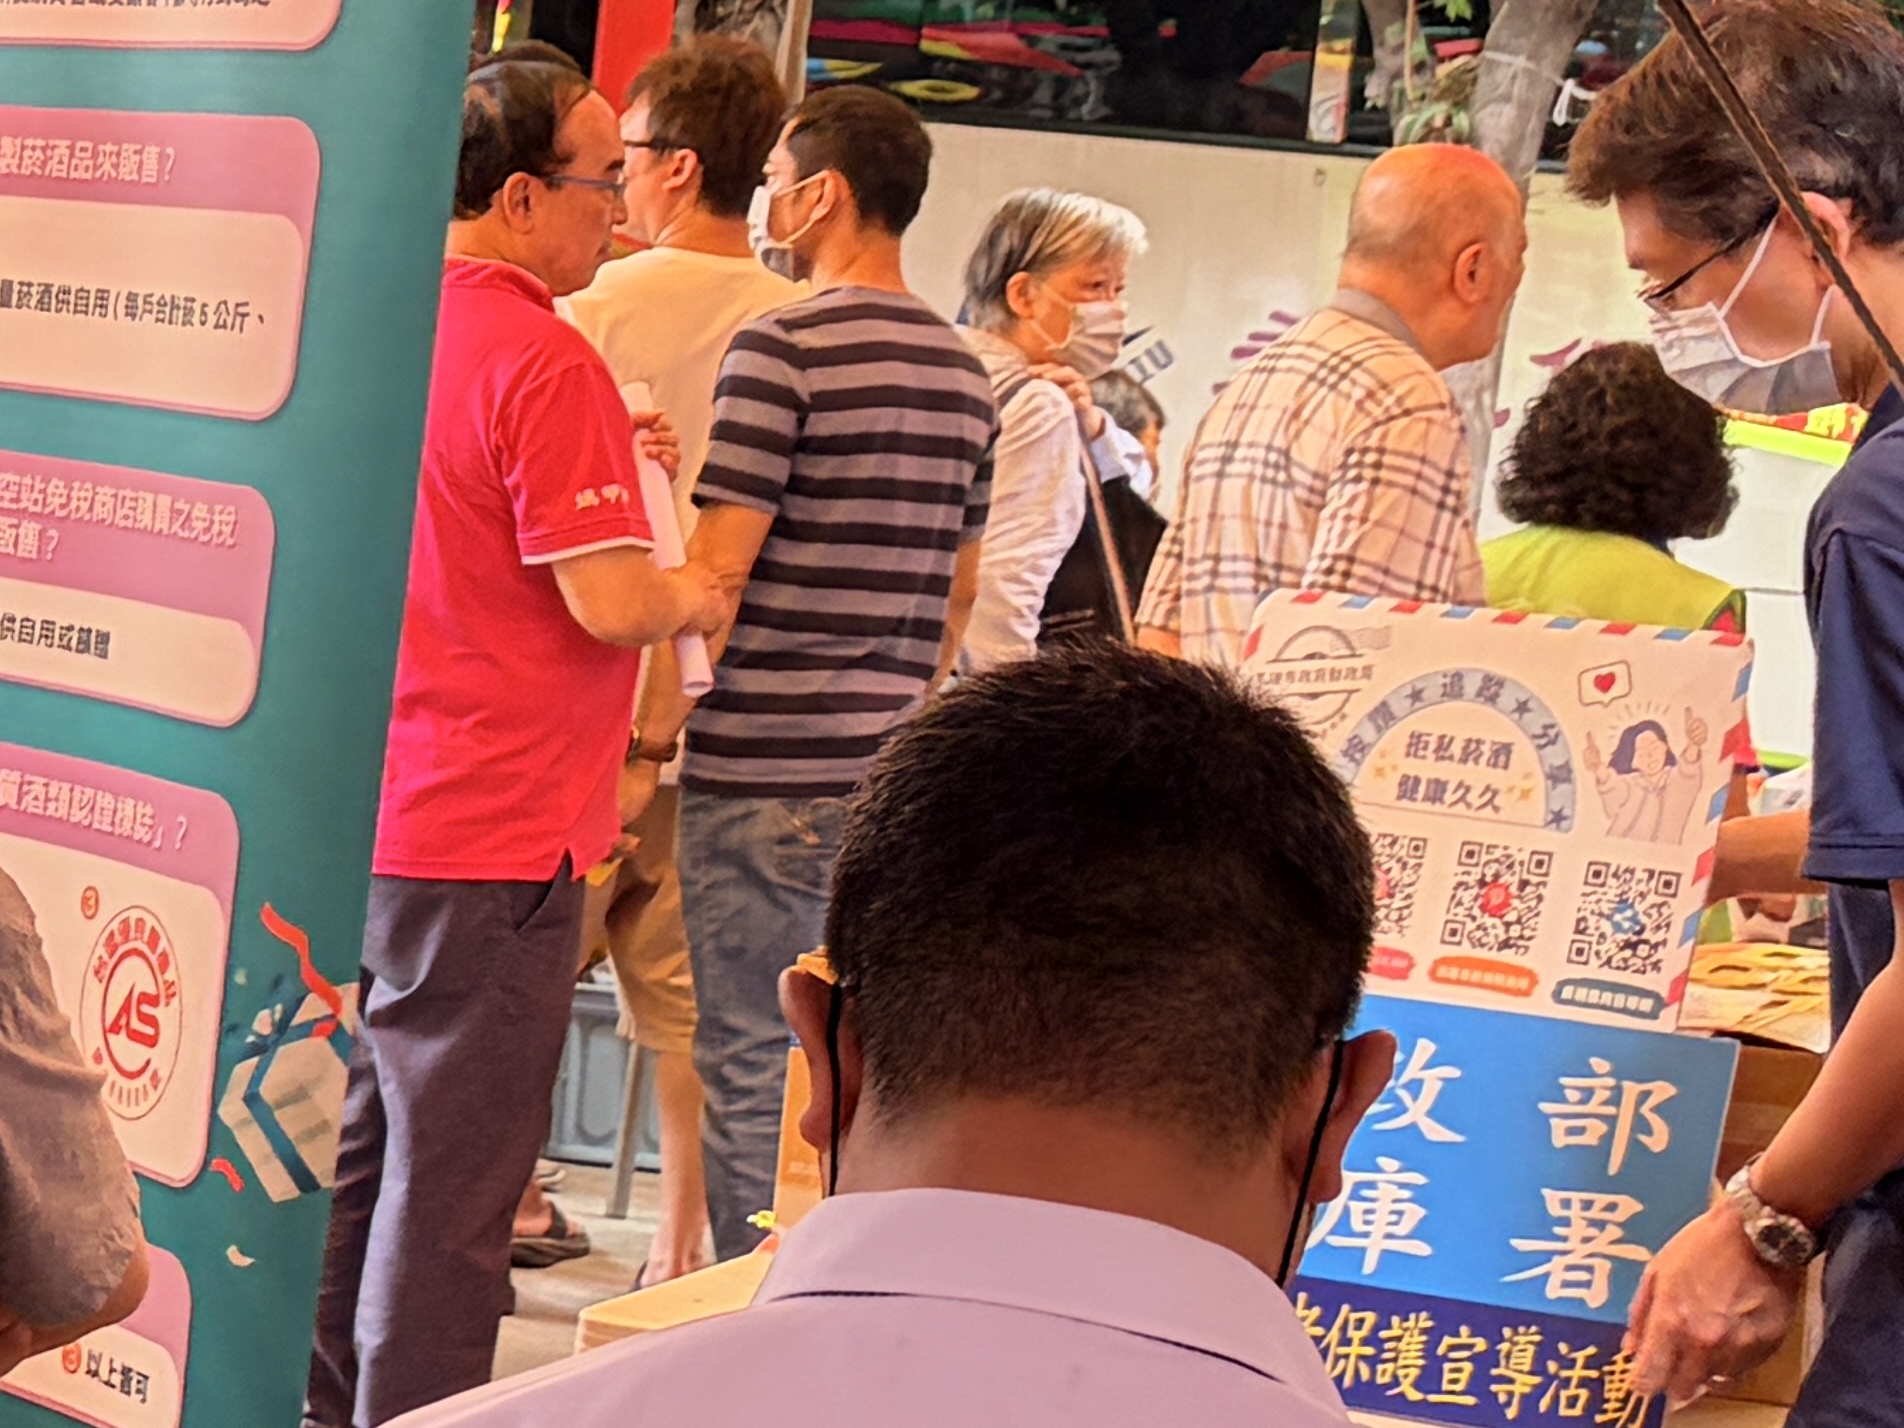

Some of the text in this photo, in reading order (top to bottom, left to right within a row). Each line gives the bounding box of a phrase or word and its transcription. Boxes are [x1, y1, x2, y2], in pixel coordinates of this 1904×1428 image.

[1404, 730, 1515, 771] 拒私菸酒
[1395, 773, 1501, 814] 健康久久
